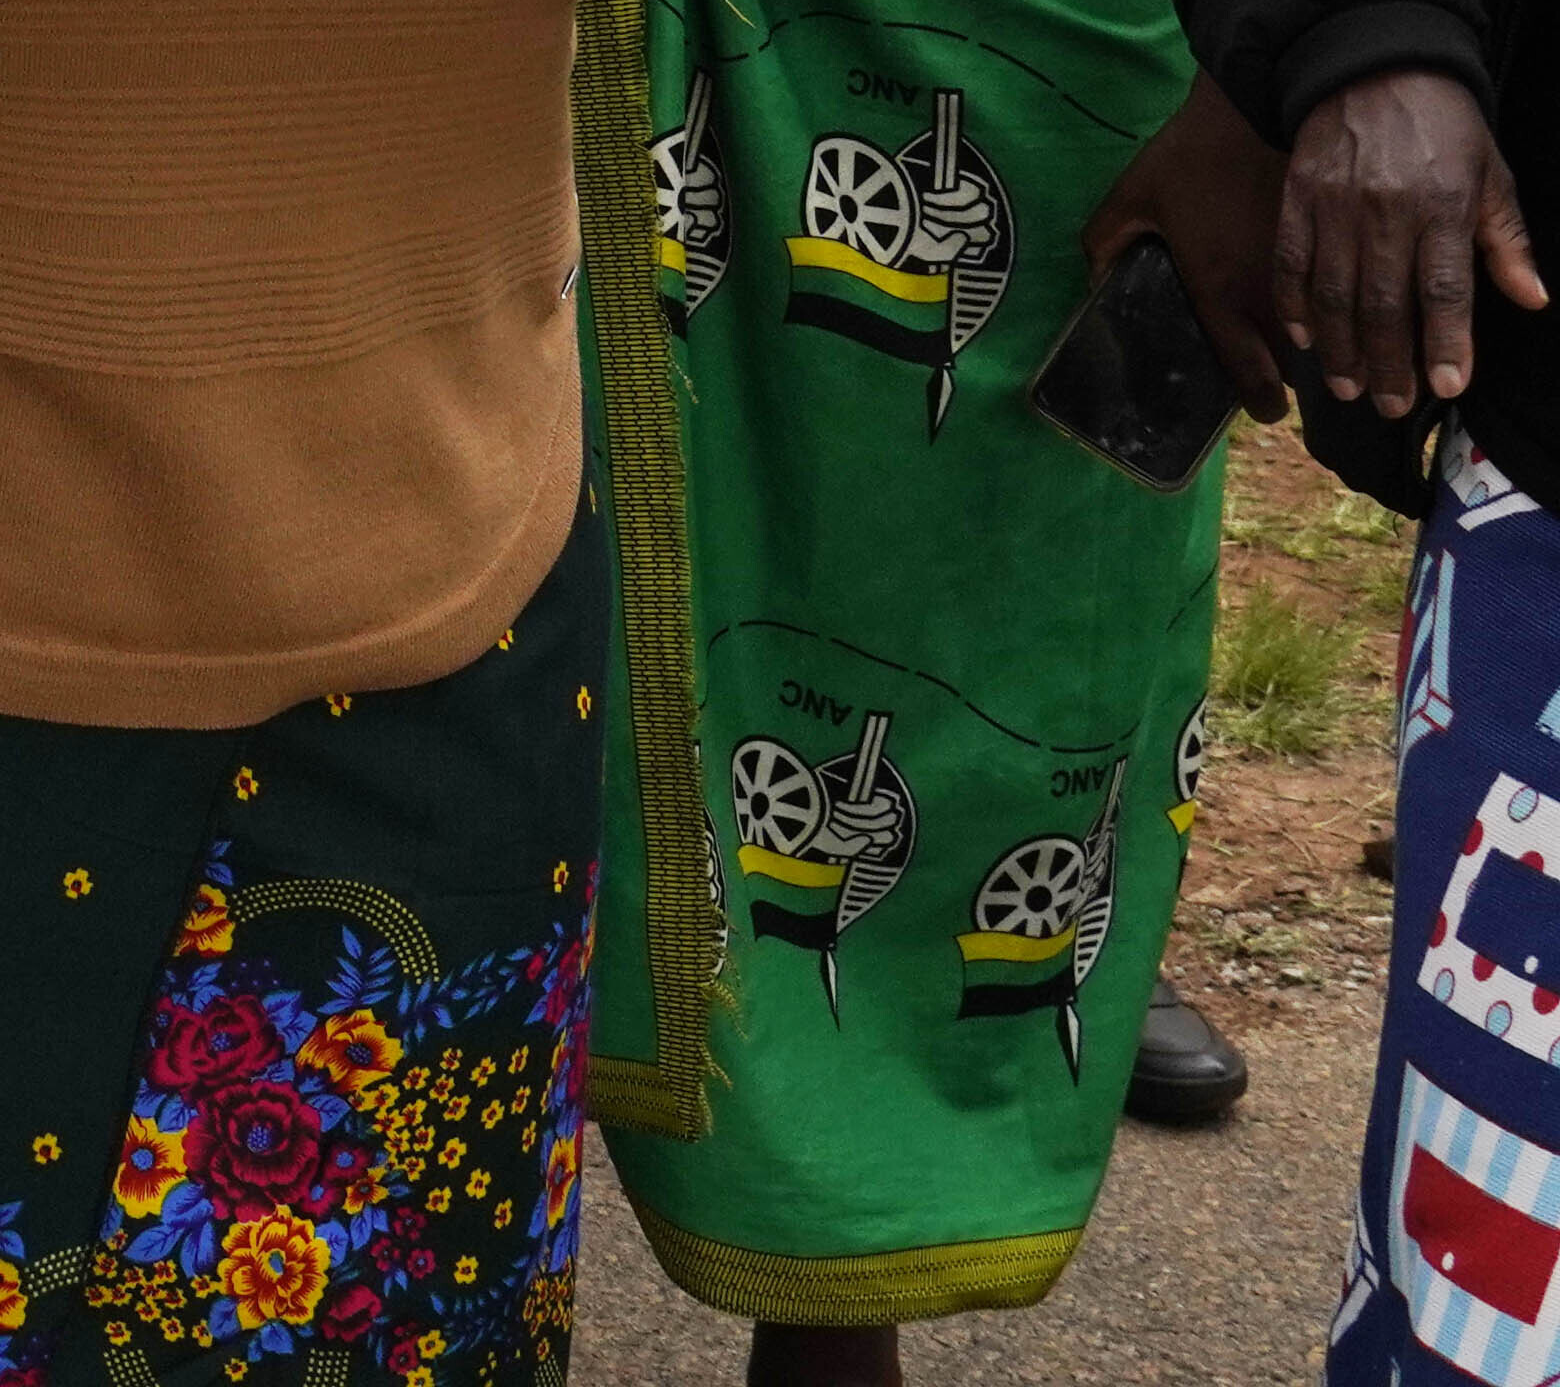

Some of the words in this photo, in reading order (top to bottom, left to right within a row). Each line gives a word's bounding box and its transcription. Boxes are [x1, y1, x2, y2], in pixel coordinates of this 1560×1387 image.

[846, 68, 925, 107] ANC
[778, 679, 855, 726] ANC
[1050, 764, 1112, 798] ANC
